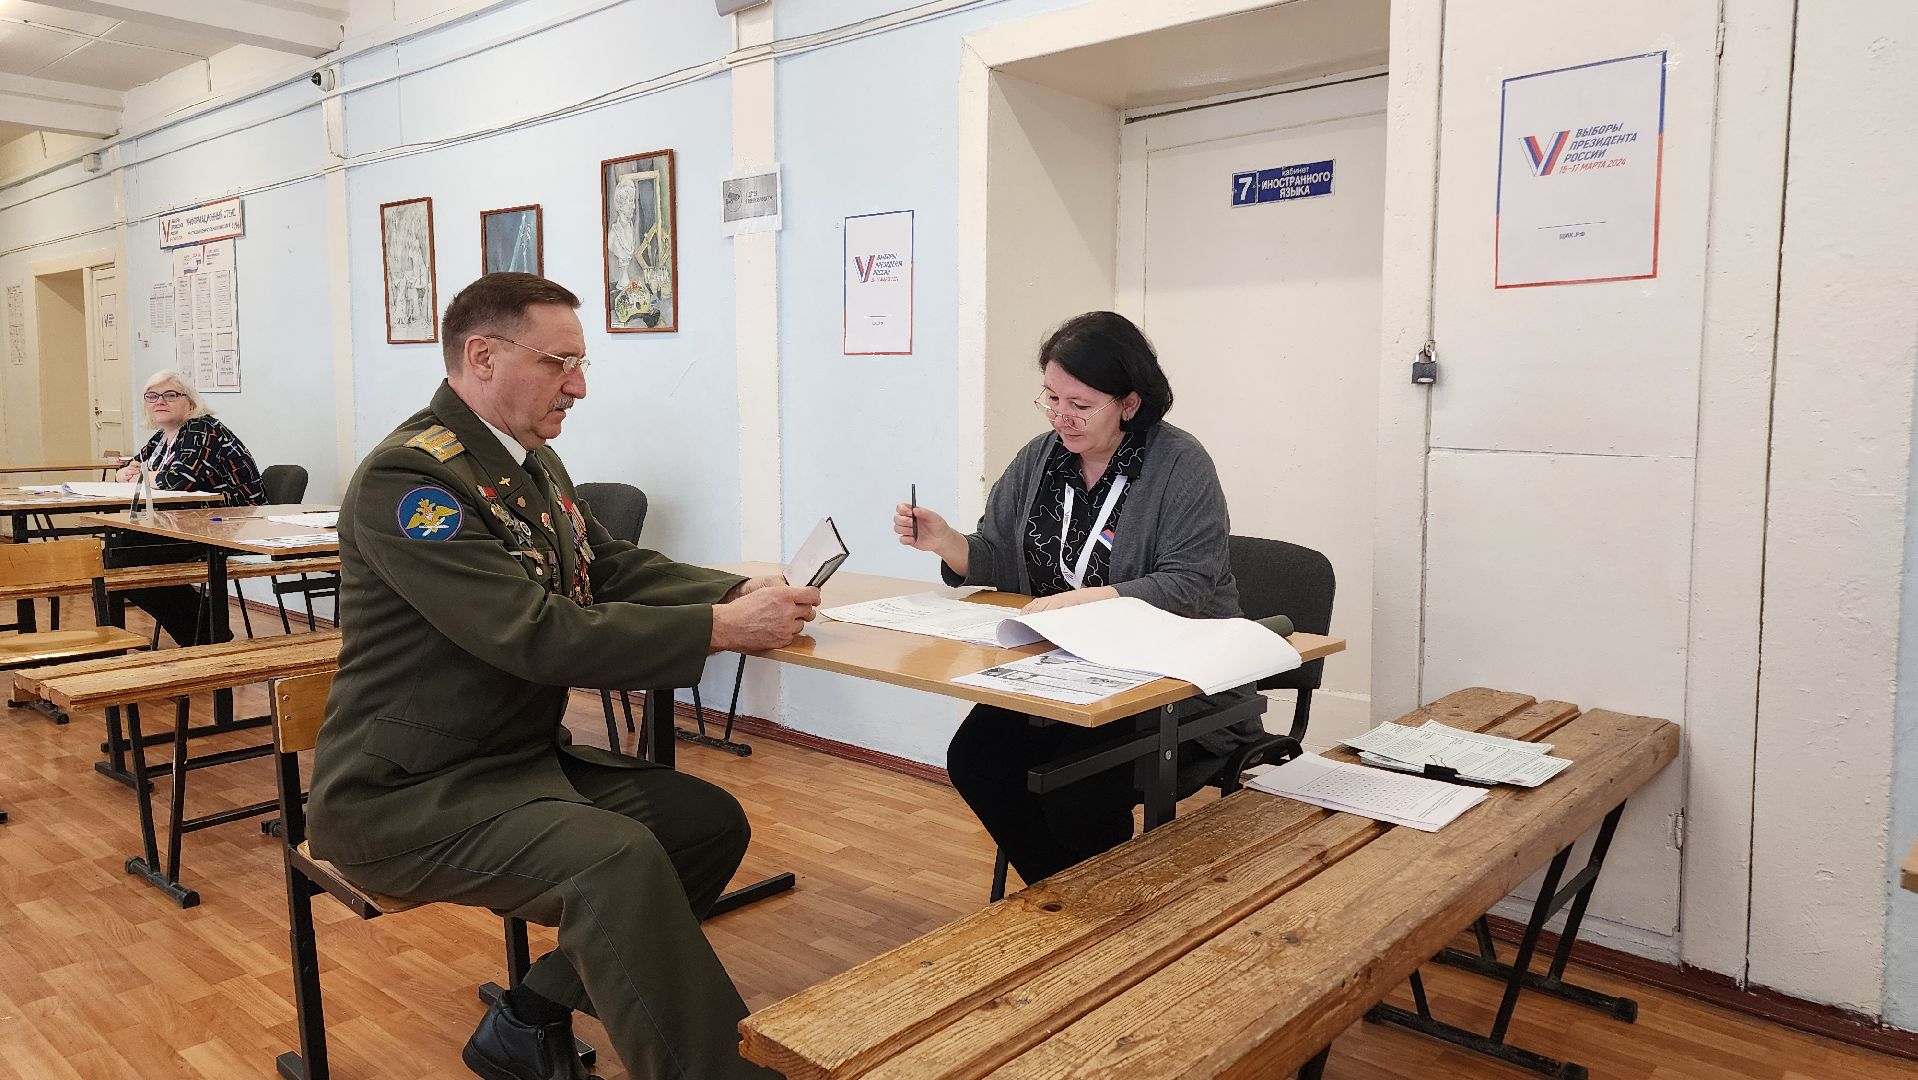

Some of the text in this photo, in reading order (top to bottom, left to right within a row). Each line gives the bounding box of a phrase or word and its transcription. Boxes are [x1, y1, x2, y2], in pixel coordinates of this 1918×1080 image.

[1575, 122, 1624, 138] ВЫБОРЫ
[1568, 133, 1638, 151] ПРЕЗИДЕНТА
[1563, 149, 1607, 163] РОССИИ
[1281, 166, 1310, 177] кабинет
[1581, 162, 1606, 172] МАРТА
[1607, 158, 1626, 168] 2024
[1261, 171, 1331, 190] ИНОСТРАННОГО
[1238, 176, 1253, 201] 7
[1279, 185, 1310, 199] ЯЗЫКА
